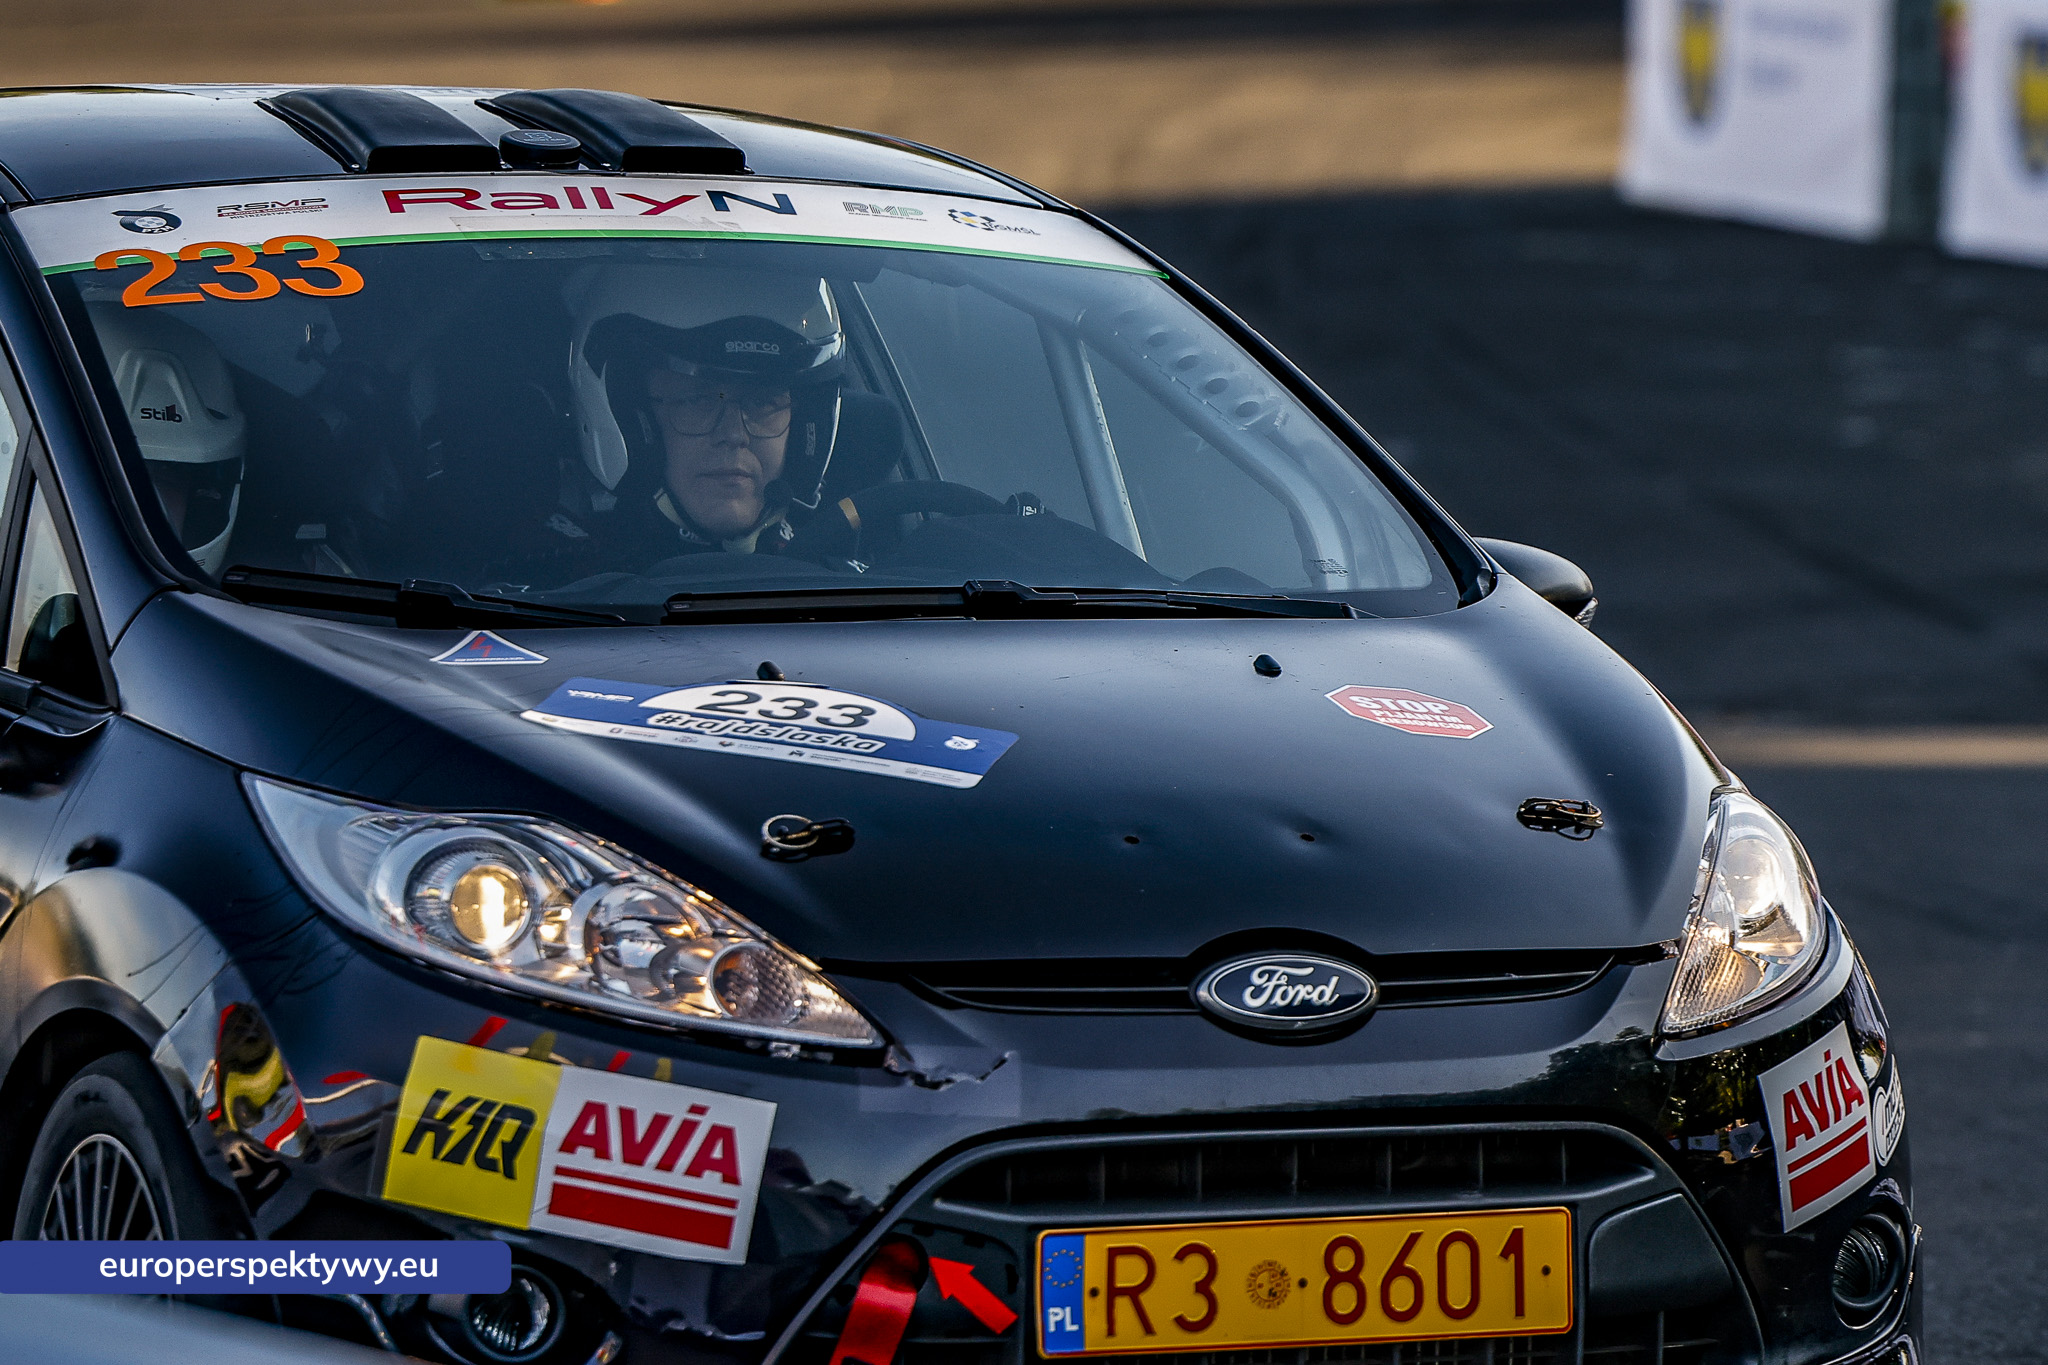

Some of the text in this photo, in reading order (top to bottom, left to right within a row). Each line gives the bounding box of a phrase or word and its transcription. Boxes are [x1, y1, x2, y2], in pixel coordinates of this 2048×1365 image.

[217, 198, 327, 214] RSMP
[381, 186, 797, 215] RallyN
[842, 201, 924, 217] RMP
[94, 235, 364, 308] 233
[695, 690, 877, 728] 233
[1349, 695, 1450, 714] STOP
[1369, 709, 1464, 724] PIJANYM
[1242, 965, 1340, 1008] Ford
[1106, 1242, 1219, 1337] R3
[1322, 1226, 1525, 1326] 8601
[1048, 1309, 1079, 1333] PL
